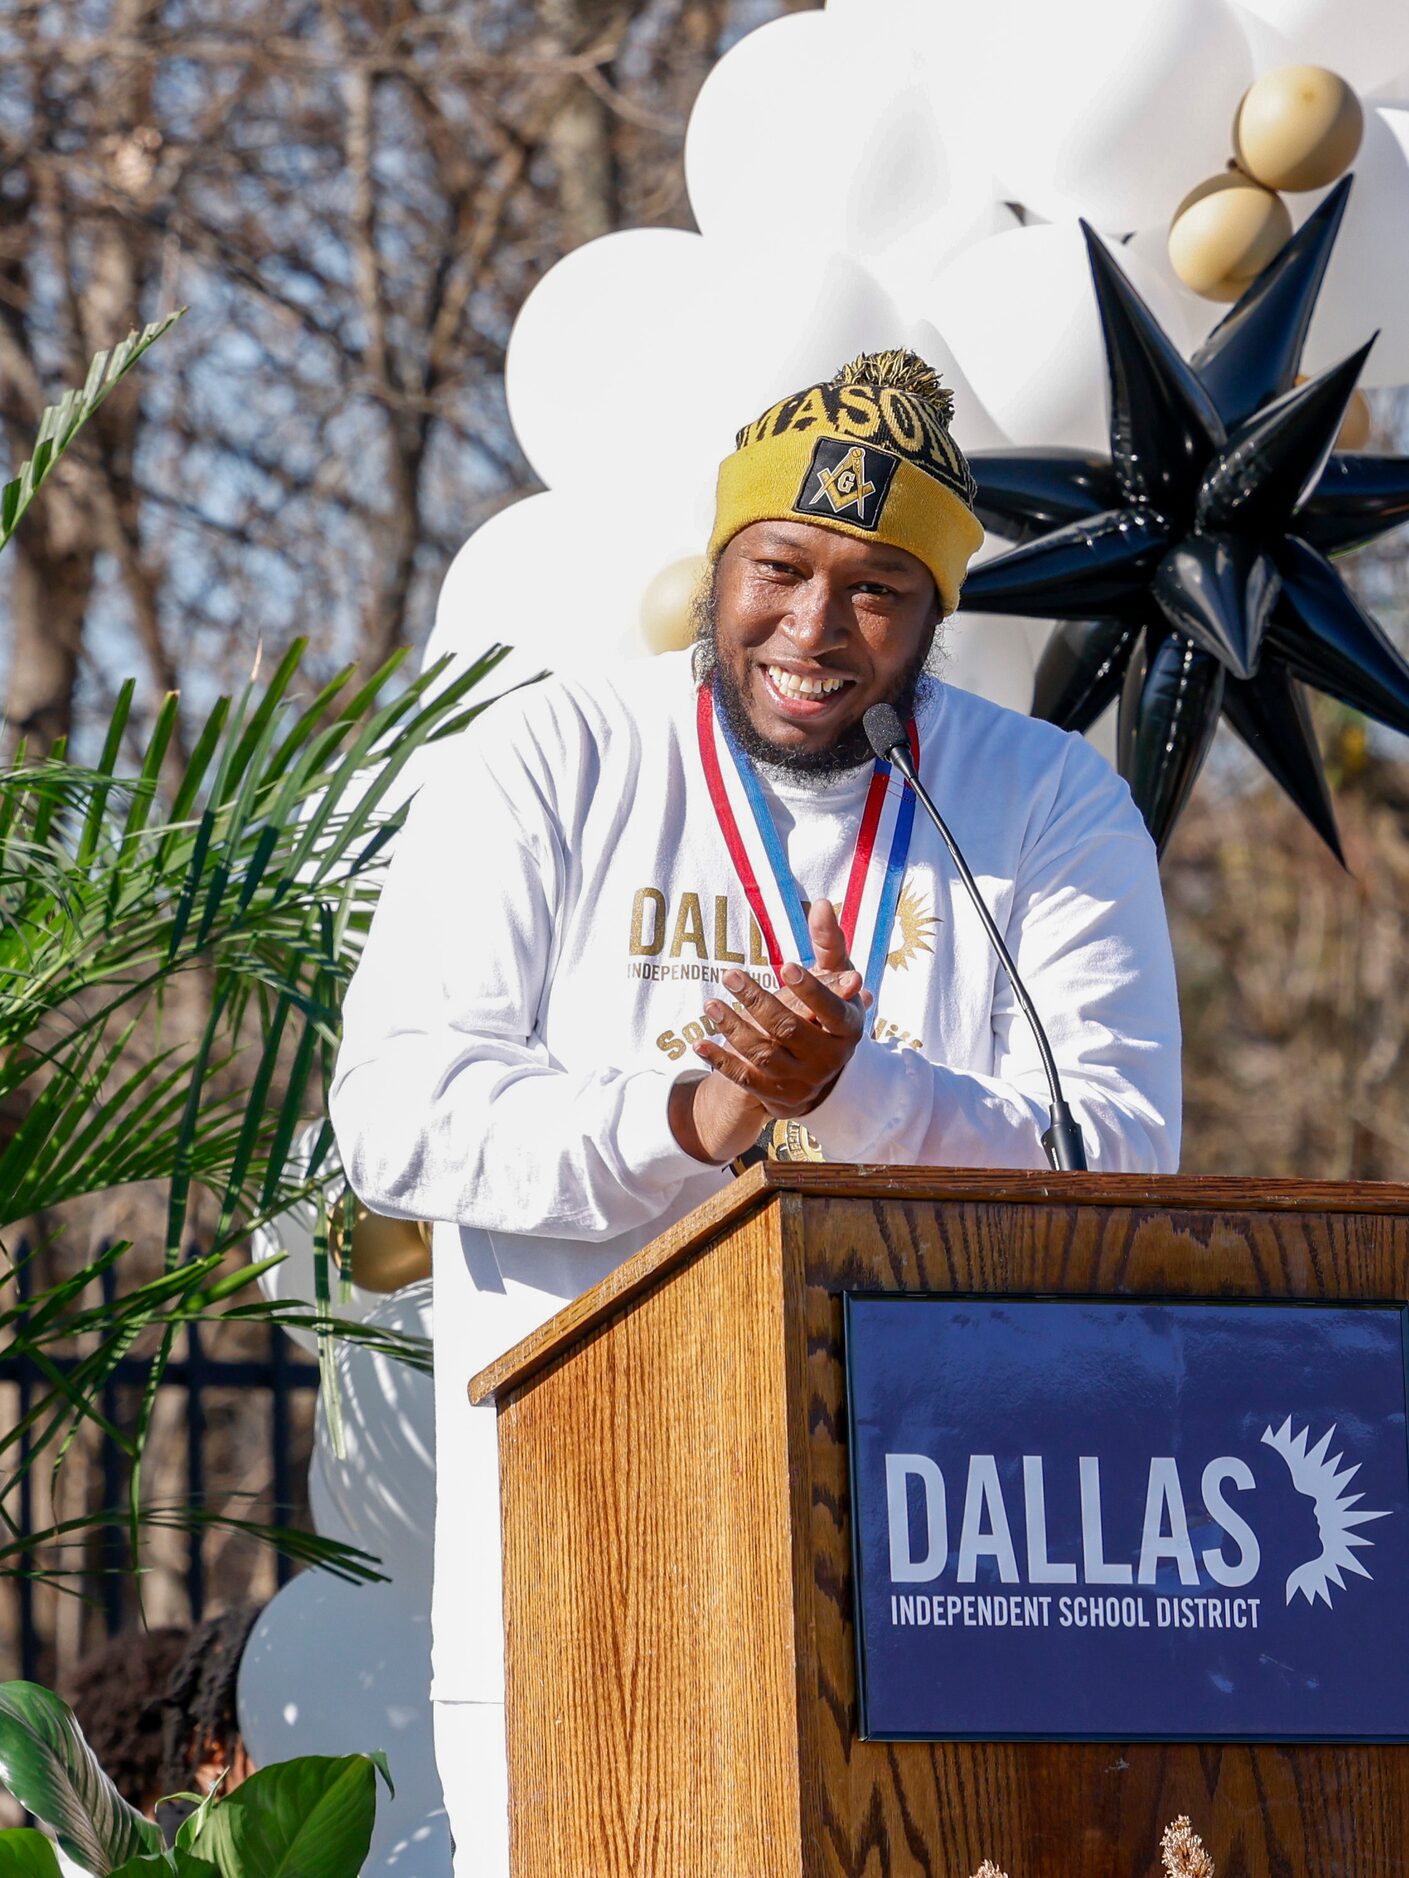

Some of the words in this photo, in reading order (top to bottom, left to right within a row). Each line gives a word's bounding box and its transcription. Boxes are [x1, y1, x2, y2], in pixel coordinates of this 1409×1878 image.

[837, 472, 856, 494] G
[885, 1453, 1262, 1588] DALLAS
[891, 1595, 1052, 1627] INDEPENDENT
[1059, 1596, 1151, 1628] SCHOOL
[1156, 1597, 1261, 1629] DISTRICT
